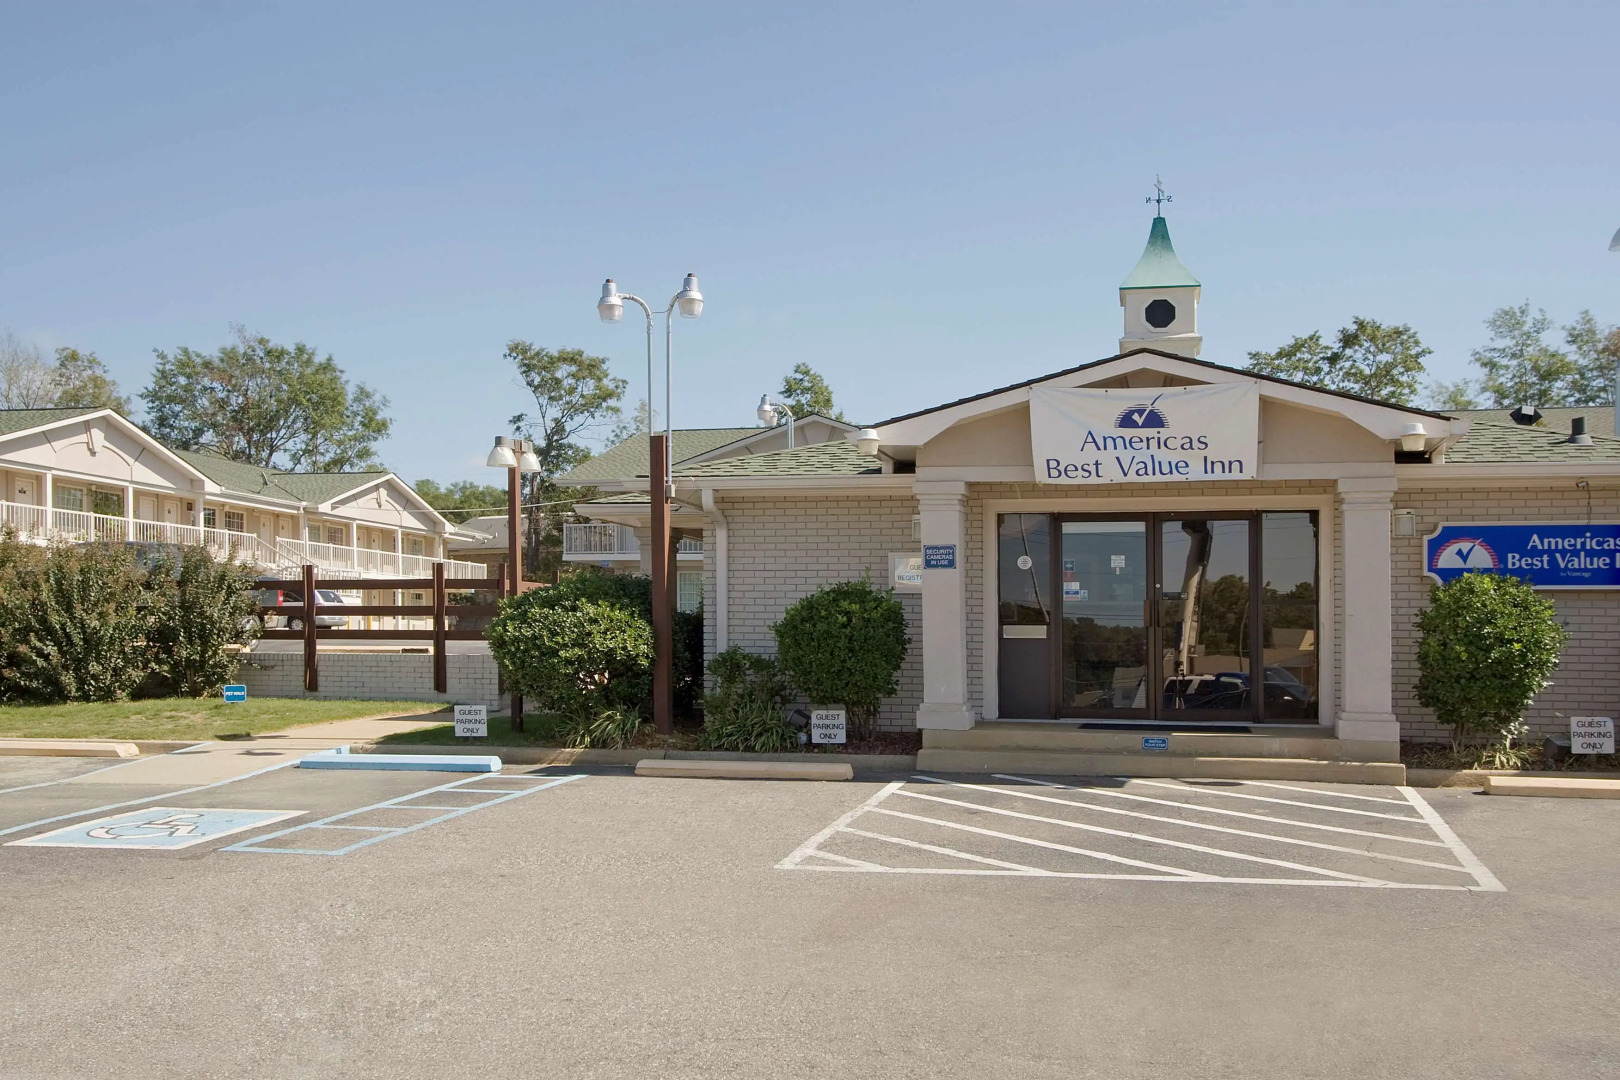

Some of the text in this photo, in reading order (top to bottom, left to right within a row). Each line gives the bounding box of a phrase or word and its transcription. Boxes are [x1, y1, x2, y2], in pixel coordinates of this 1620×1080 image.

[1080, 430, 1209, 452] Americas
[1045, 454, 1244, 479] Best Value Inn
[1507, 553, 1550, 569] Best
[1555, 551, 1611, 569] Value
[815, 713, 841, 721] GUEST
[1576, 720, 1607, 728] GUEST
[819, 732, 838, 740] ONLY
[1572, 731, 1612, 739] PARKING
[1580, 742, 1604, 750] ONLY
